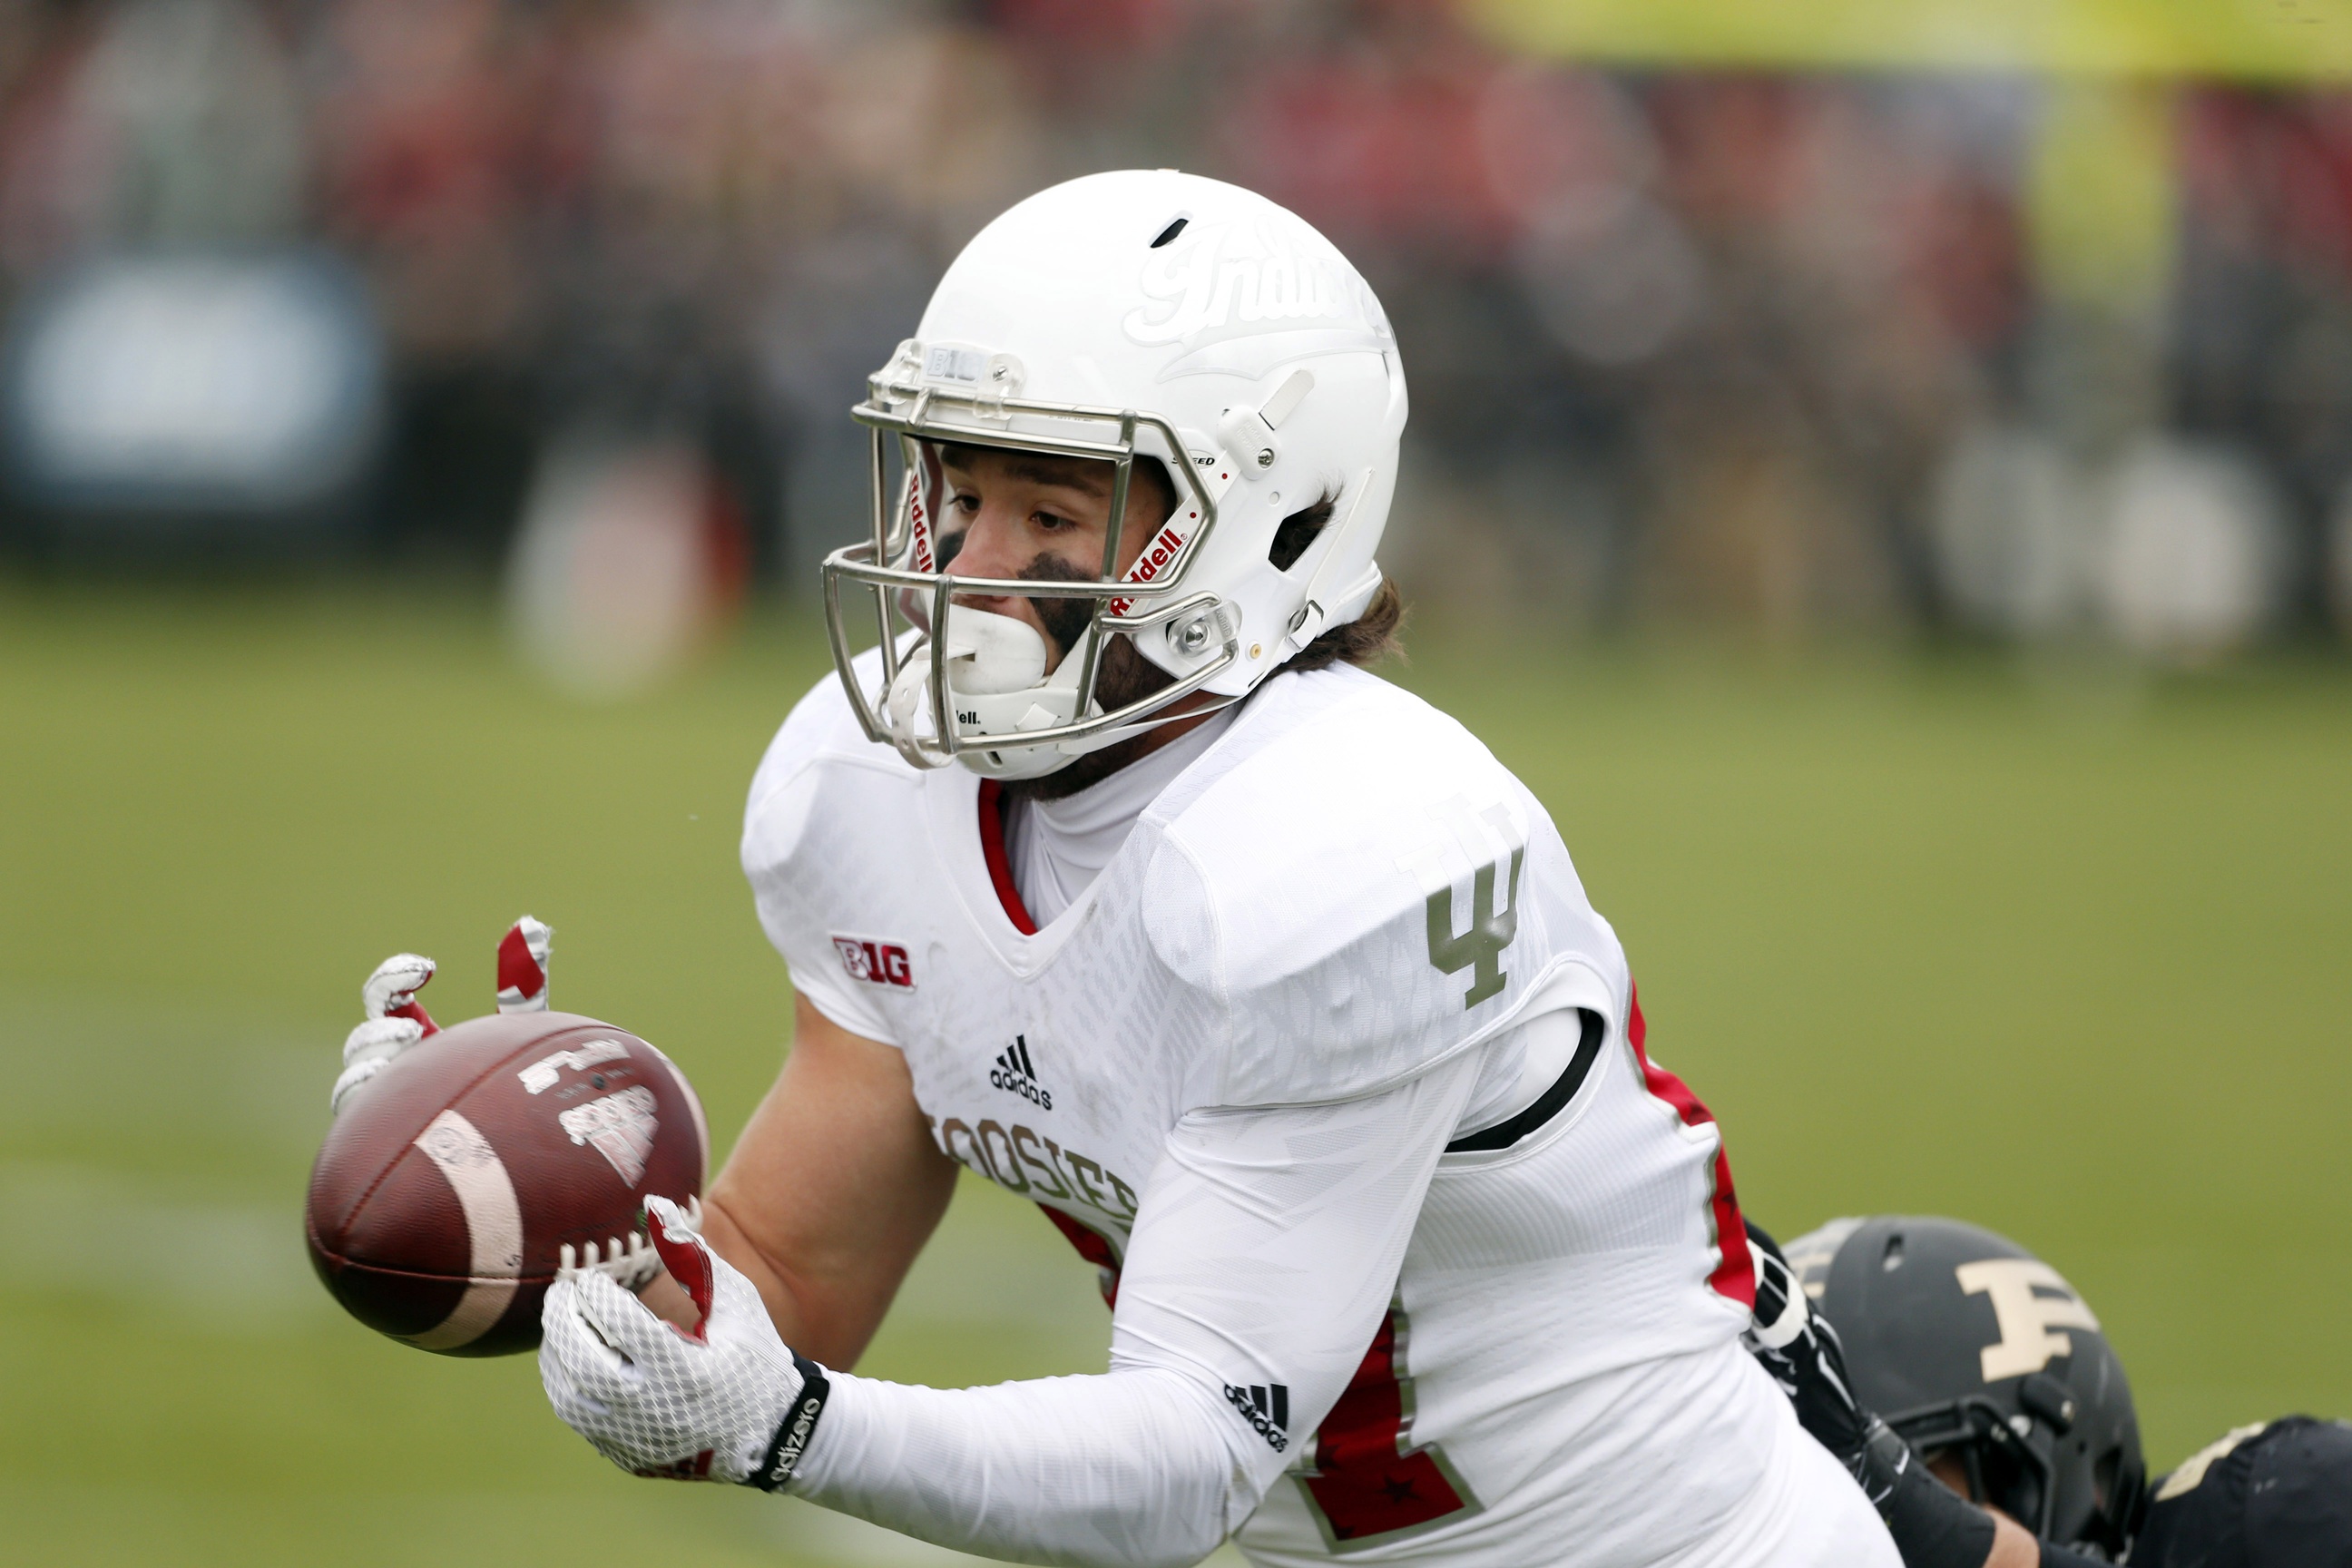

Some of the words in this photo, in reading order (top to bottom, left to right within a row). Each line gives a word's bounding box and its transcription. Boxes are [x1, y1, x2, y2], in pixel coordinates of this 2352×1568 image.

[1171, 457, 1215, 466] SEED
[1110, 528, 1183, 616] Rdell
[990, 1066, 1053, 1112] adidas
[927, 1115, 1139, 1240] OOSIER
[769, 1397, 821, 1482] adizero
[1224, 1384, 1289, 1453] adidas
